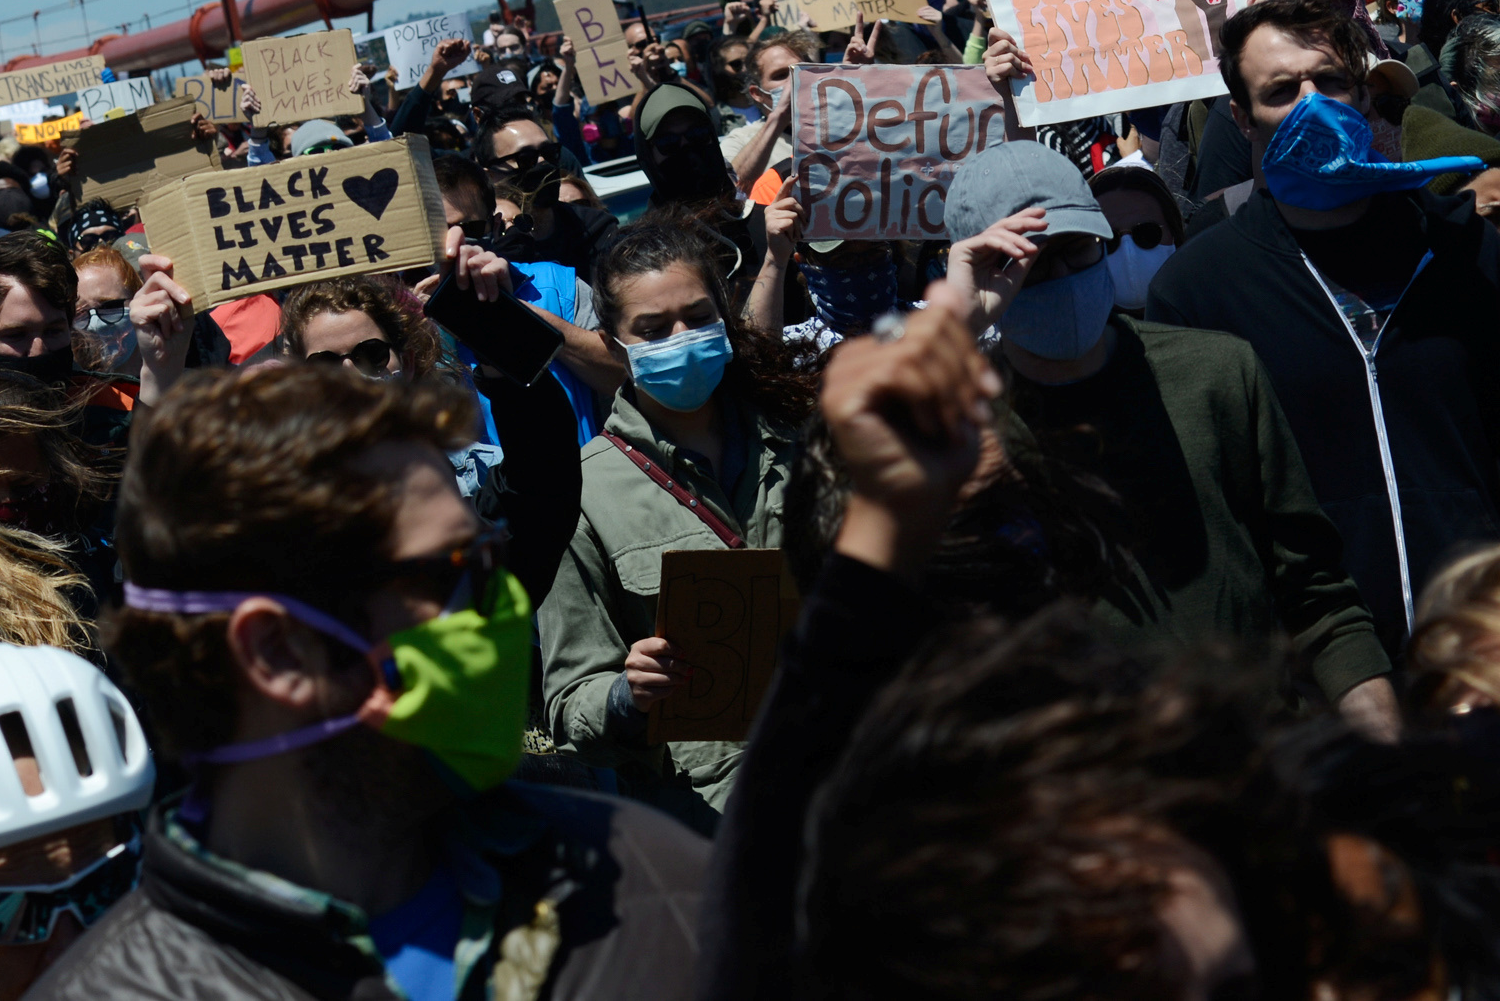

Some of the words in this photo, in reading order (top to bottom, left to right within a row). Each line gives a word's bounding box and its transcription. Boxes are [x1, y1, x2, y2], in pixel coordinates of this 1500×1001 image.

[393, 16, 449, 51] POLICE
[421, 28, 466, 56] POICY
[53, 57, 94, 74] LIVES
[260, 40, 333, 77] BLACK
[1025, 29, 1204, 103] MATTER
[54, 67, 102, 94] MATTER
[269, 69, 332, 99] LIVES
[81, 79, 151, 122] BLM
[273, 83, 350, 117] MATTER
[206, 166, 332, 219] BLACK
[213, 202, 336, 251] LIVES
[221, 233, 391, 291] MATTER
